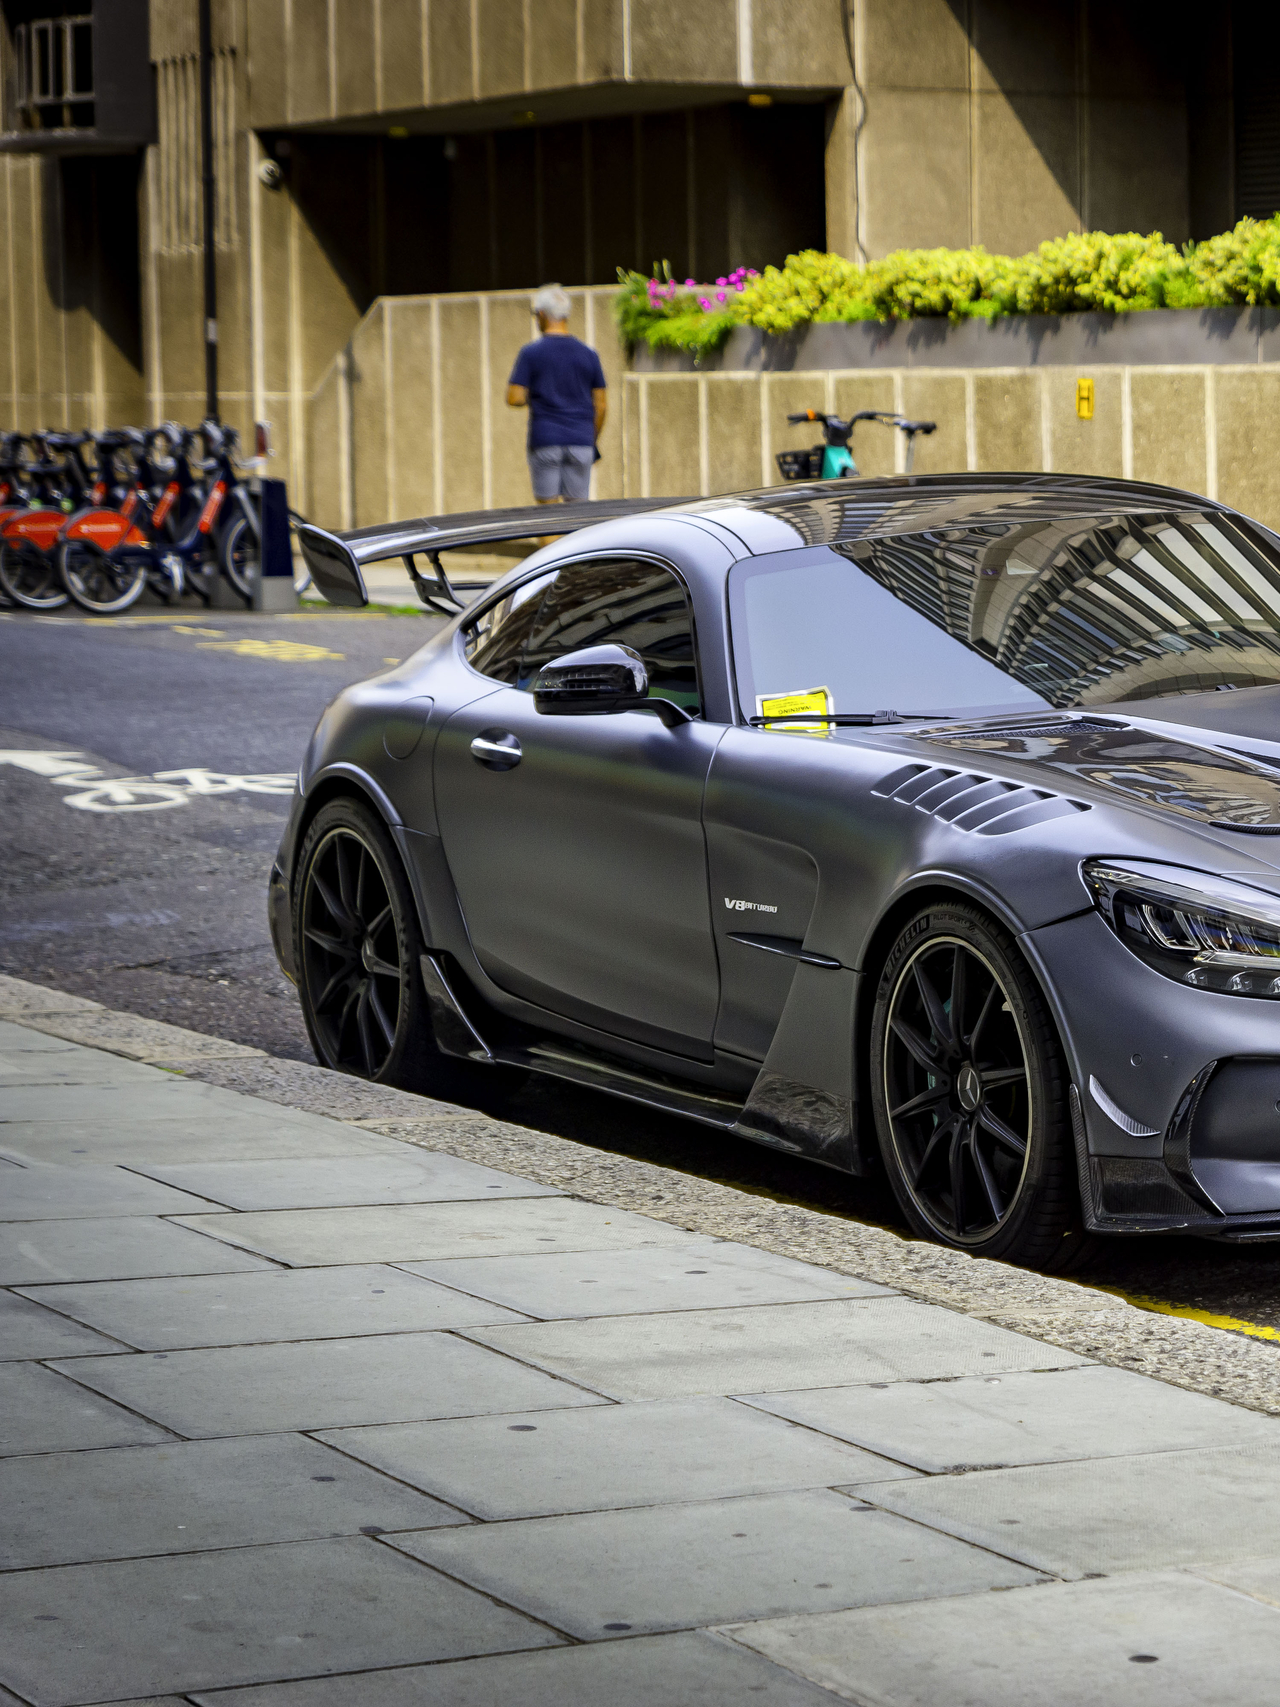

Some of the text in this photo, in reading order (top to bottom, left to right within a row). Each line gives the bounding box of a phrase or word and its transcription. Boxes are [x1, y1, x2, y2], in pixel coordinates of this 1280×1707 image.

[778, 705, 812, 715] WARNING
[724, 897, 778, 914] V8 BITURBO
[885, 916, 929, 977] MICHELIN
